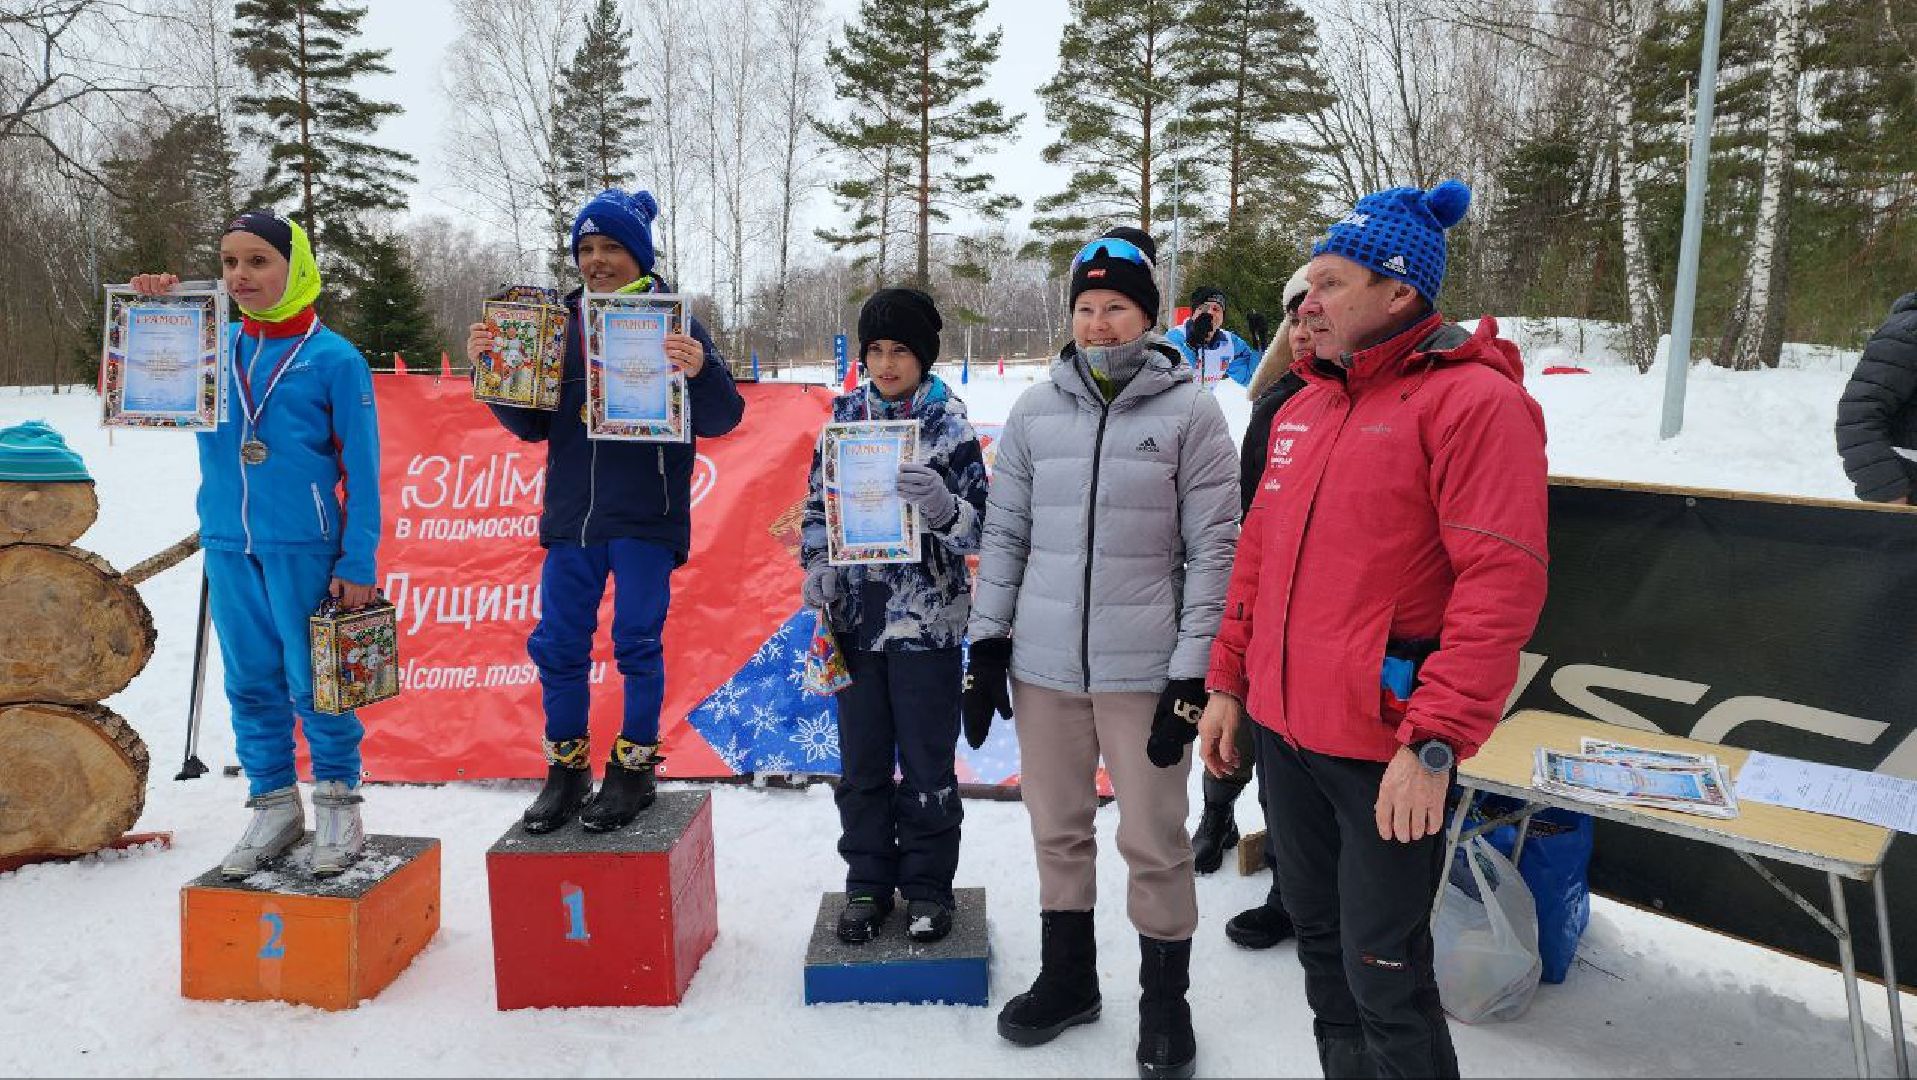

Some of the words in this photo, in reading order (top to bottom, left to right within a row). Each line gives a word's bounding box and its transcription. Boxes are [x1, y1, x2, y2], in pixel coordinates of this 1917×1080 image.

[136, 315, 193, 326] ГРАМОТА
[611, 319, 659, 329] ГРАМОТА
[402, 453, 544, 510] ЗИМ
[257, 912, 285, 959] 2
[562, 889, 591, 941] 1
